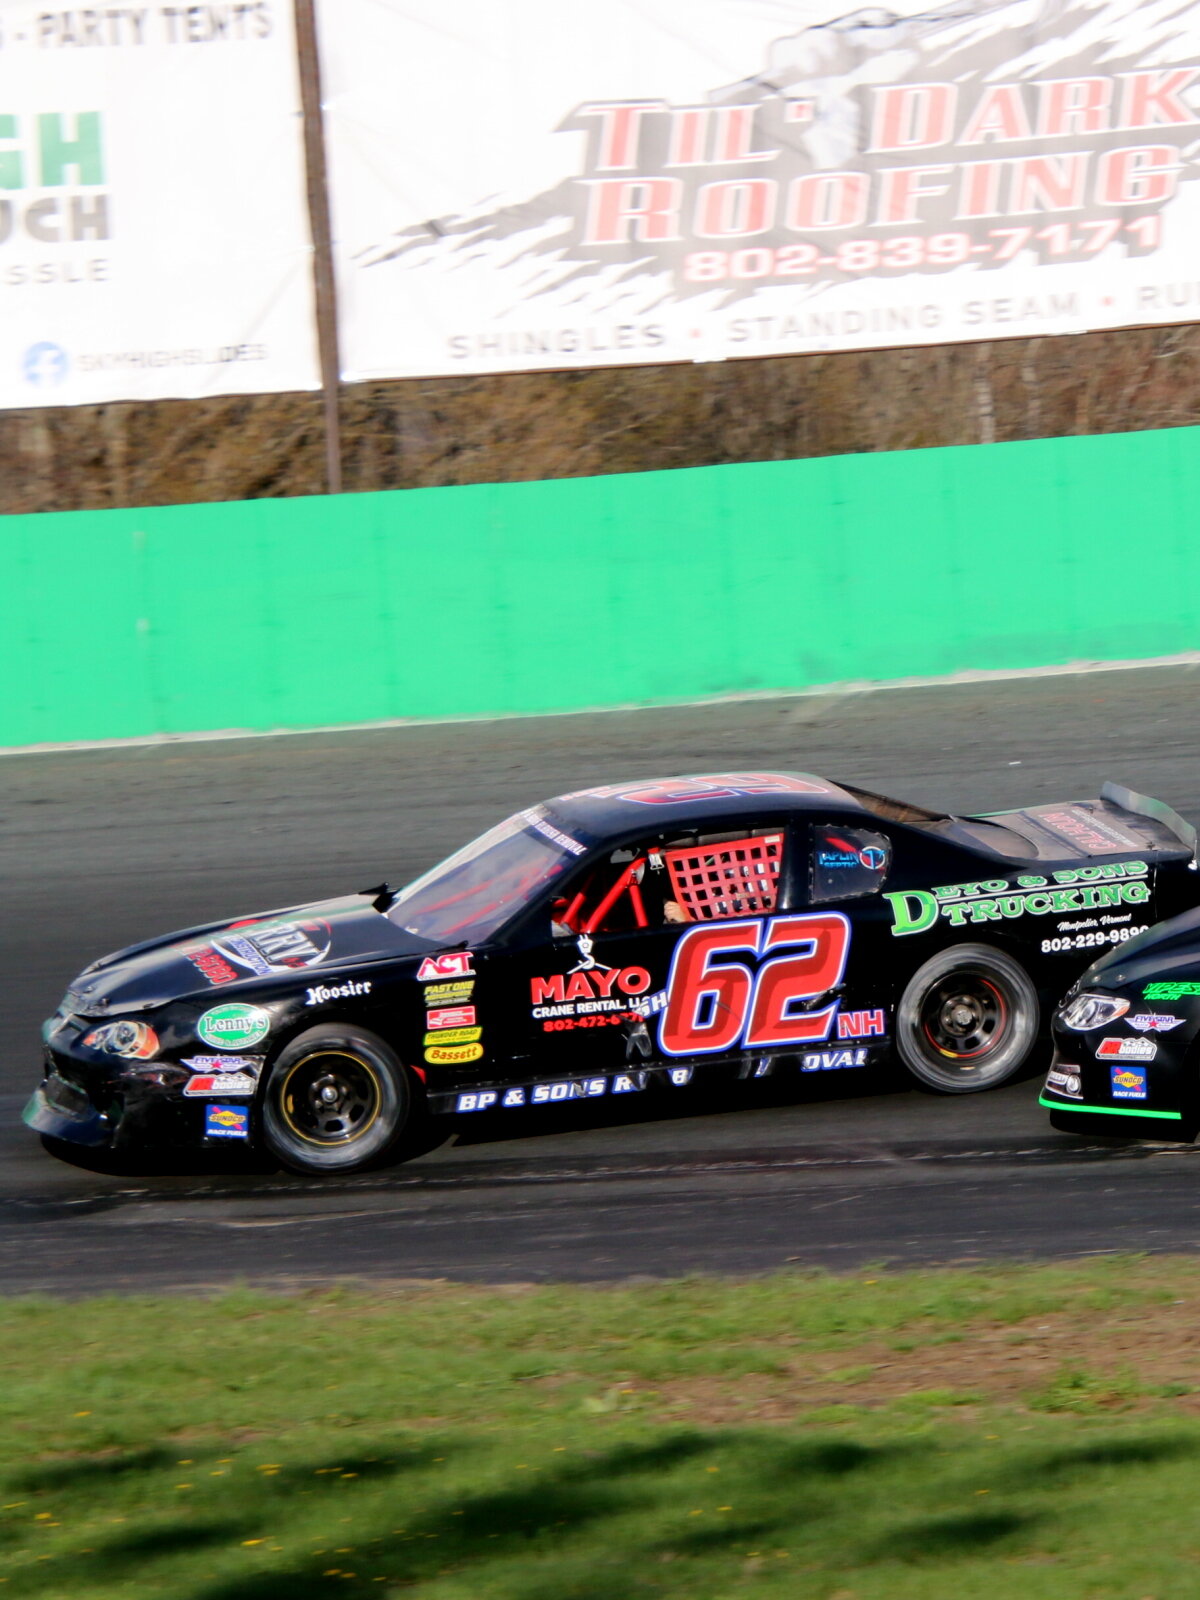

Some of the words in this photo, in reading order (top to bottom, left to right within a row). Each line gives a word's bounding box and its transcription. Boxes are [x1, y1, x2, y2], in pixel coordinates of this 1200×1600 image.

[570, 145, 1185, 246] ROOFING
[683, 214, 1164, 284] 802-839-7171
[446, 323, 668, 360] SHINGLES
[726, 304, 942, 342] STANDING
[960, 292, 1080, 325] SEAM
[1017, 875, 1047, 889] &
[1052, 860, 1150, 884] SONS
[941, 881, 1151, 927] TRUCKING
[1100, 913, 1132, 925] Vermont
[305, 979, 372, 1006] Hoosier
[530, 966, 651, 1005] MAYO
[657, 911, 852, 1057] 62
[532, 1004, 575, 1018] CRANE
[577, 1000, 626, 1013] RENTAL,
[838, 1009, 884, 1039] NH
[431, 1047, 477, 1059] Bassett
[1114, 1076, 1144, 1084] SUNOCO
[457, 1091, 497, 1113] BP
[503, 1087, 525, 1107] &
[209, 1114, 246, 1122] SUNOCO
